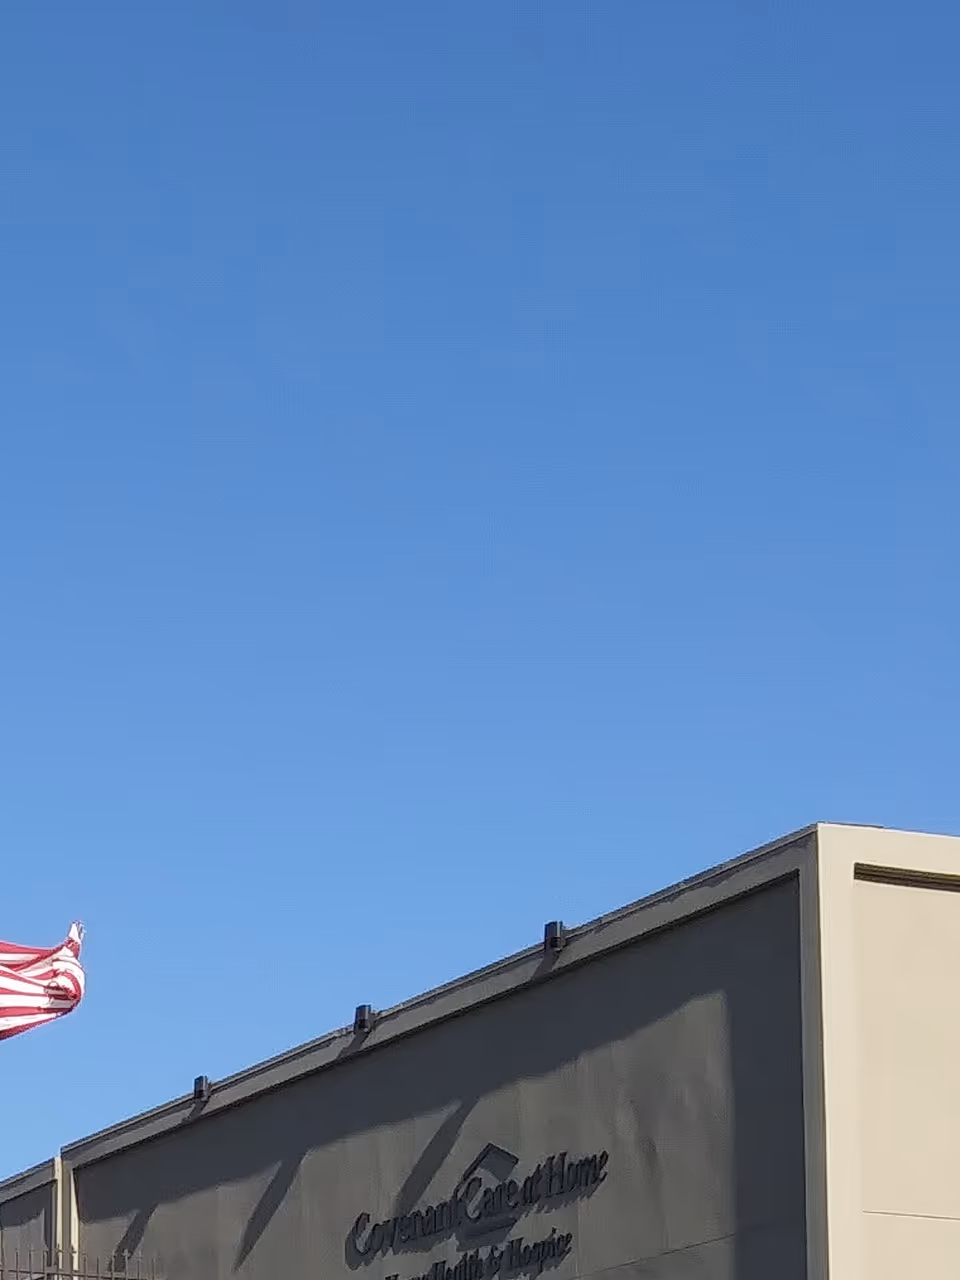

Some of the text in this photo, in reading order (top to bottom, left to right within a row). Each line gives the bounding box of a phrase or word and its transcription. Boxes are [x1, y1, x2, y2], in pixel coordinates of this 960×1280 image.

[351, 1149, 608, 1254] Covenant Care at Home
[508, 1226, 573, 1272] Hospice
